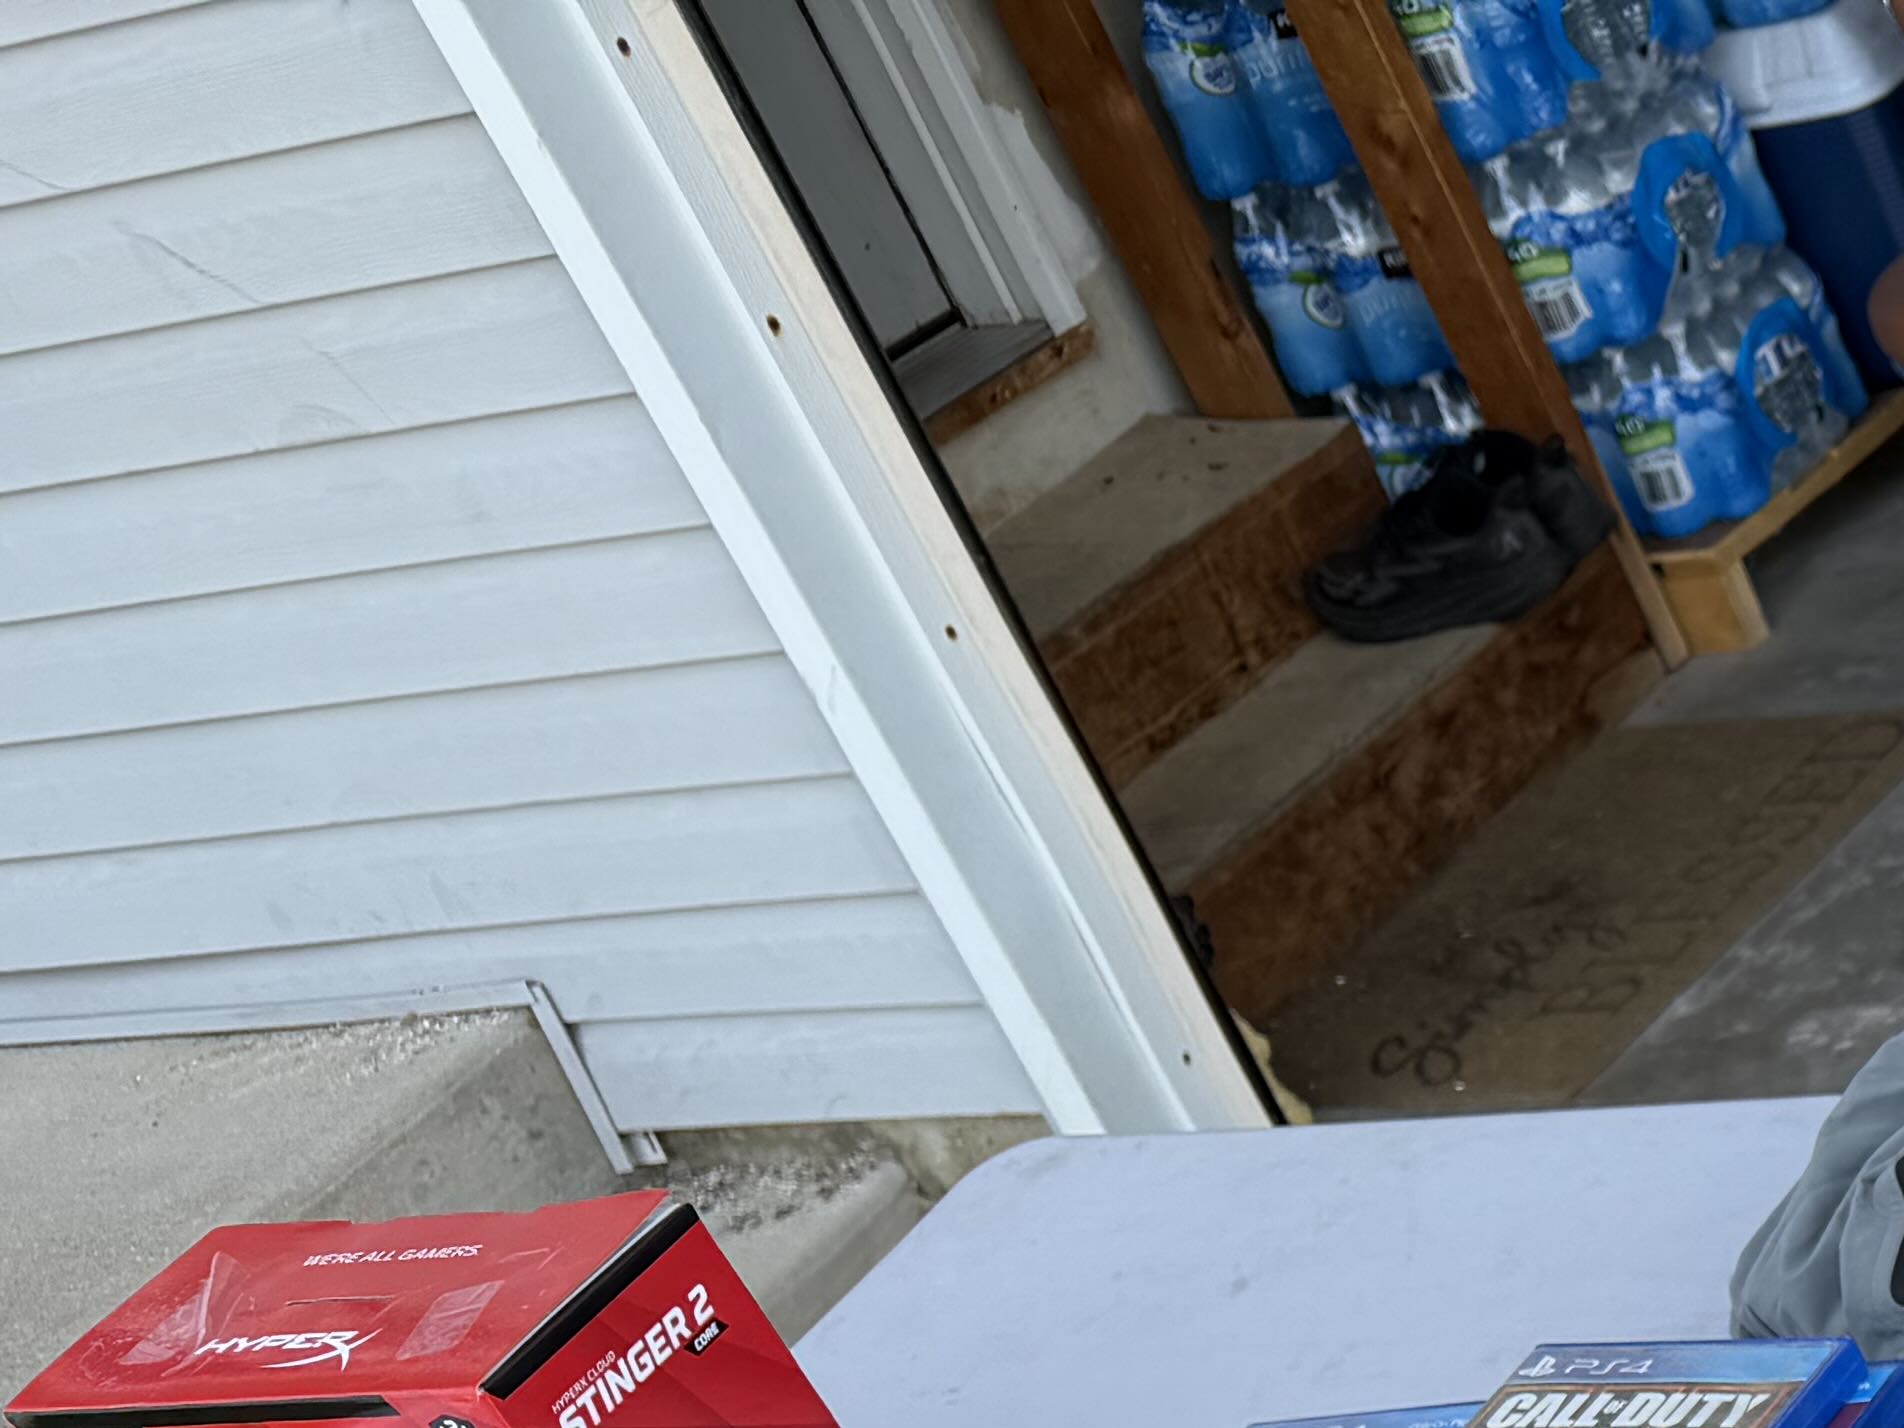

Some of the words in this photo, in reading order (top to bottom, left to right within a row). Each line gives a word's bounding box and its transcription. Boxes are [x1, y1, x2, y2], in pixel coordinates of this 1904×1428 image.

[687, 1283, 715, 1327] 2
[693, 1322, 720, 1352] CORE
[551, 1378, 588, 1415] HYPERX
[586, 1350, 616, 1382] CLOUD
[1563, 1358, 1654, 1376] PS4
[1611, 1393, 1770, 1428] DUTY
